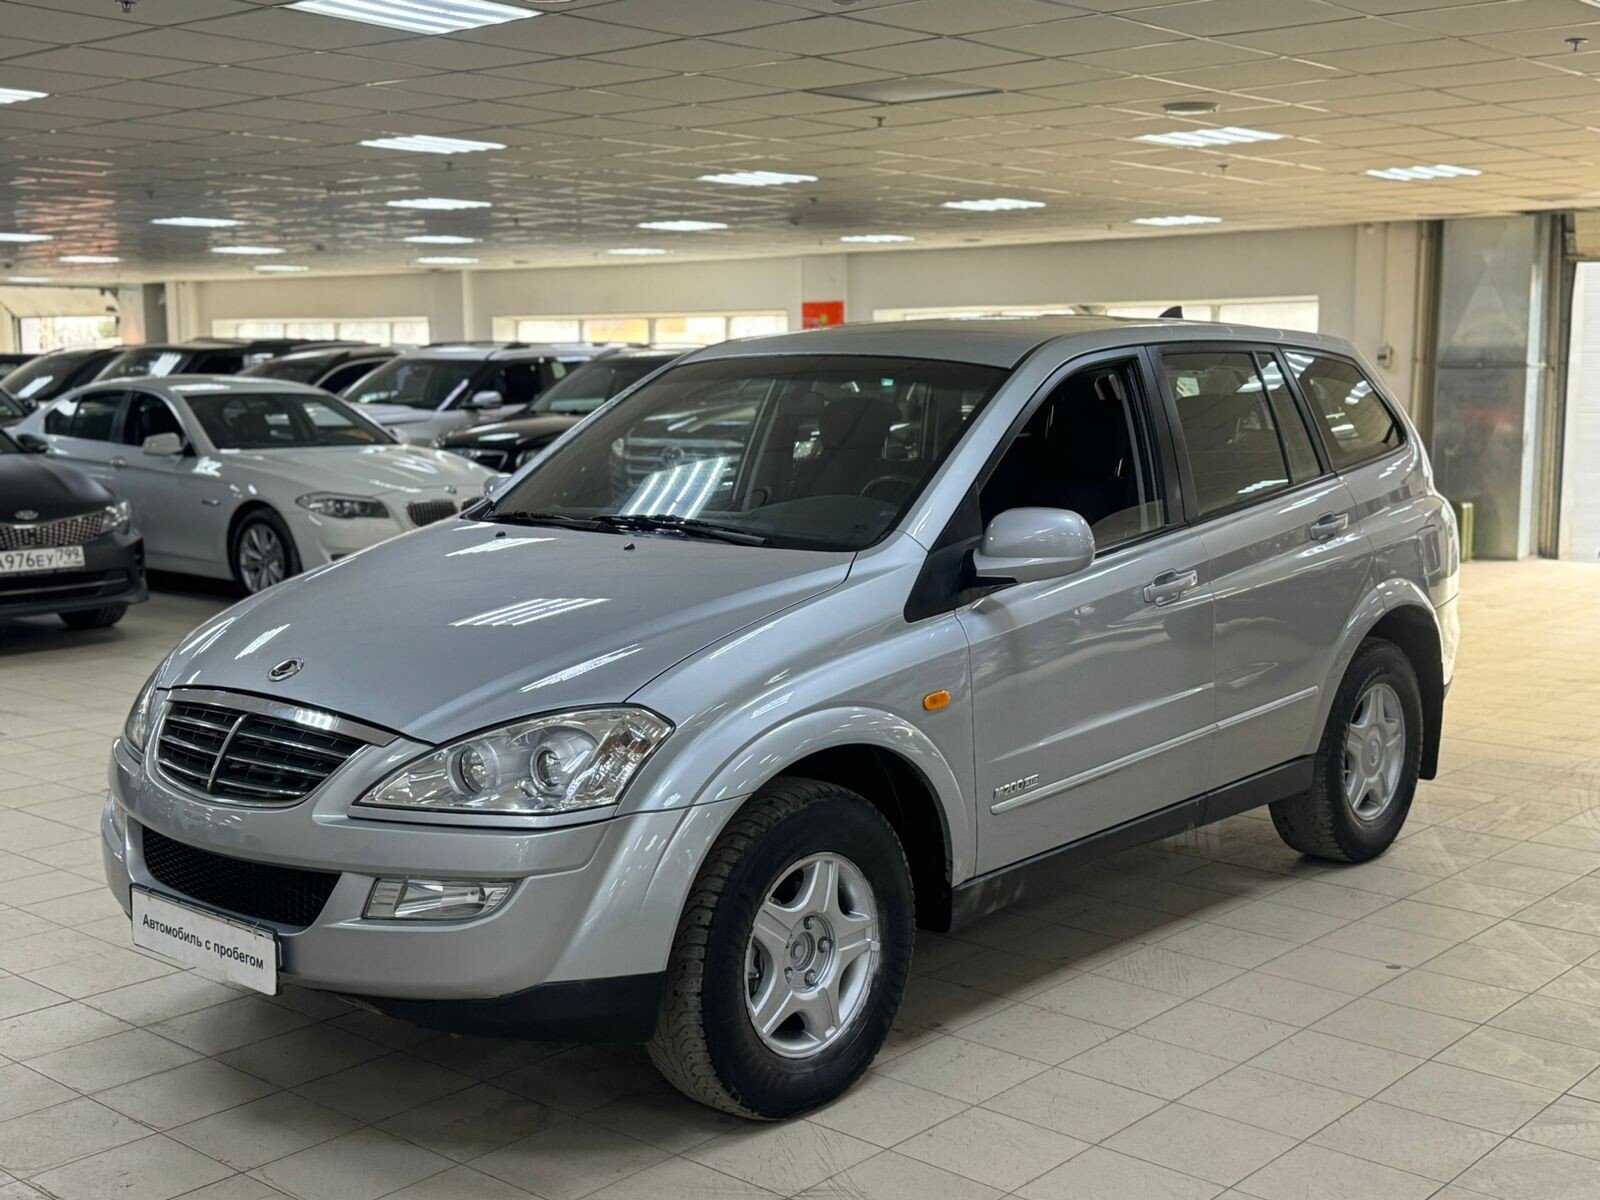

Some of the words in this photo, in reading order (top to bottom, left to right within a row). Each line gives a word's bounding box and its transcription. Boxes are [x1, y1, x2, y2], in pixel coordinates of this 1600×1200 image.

[57, 548, 79, 561] 799
[142, 914, 202, 948] Автомобиль
[205, 940, 211, 951] с
[213, 942, 264, 970] пробегом
